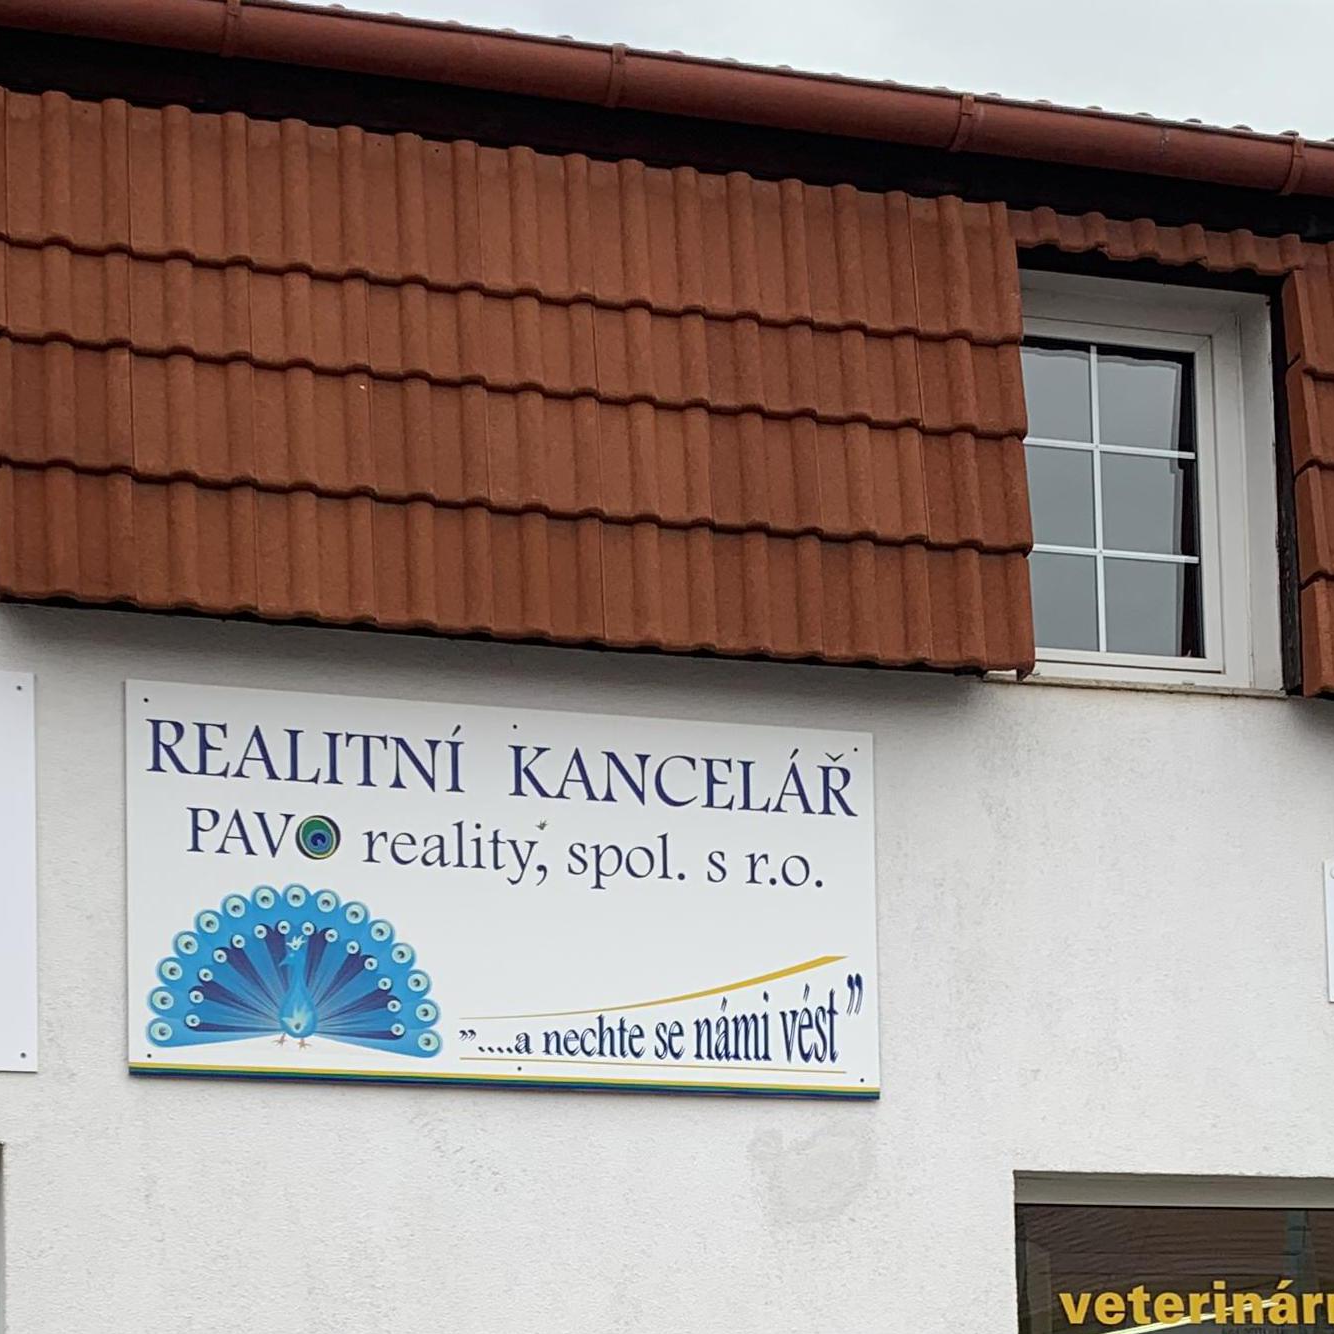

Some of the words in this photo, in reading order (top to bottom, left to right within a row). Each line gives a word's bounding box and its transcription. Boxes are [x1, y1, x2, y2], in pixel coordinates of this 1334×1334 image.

[145, 718, 466, 794] REALITNÍ
[508, 744, 859, 818] KANCELÁŘ
[186, 806, 341, 860] PAVO
[362, 820, 548, 887] reality,
[567, 832, 687, 891] spol.
[707, 849, 727, 884] s
[745, 852, 824, 889] r.o.
[541, 1012, 648, 1059] nechte
[654, 1018, 685, 1061] se
[693, 991, 773, 1063] námi
